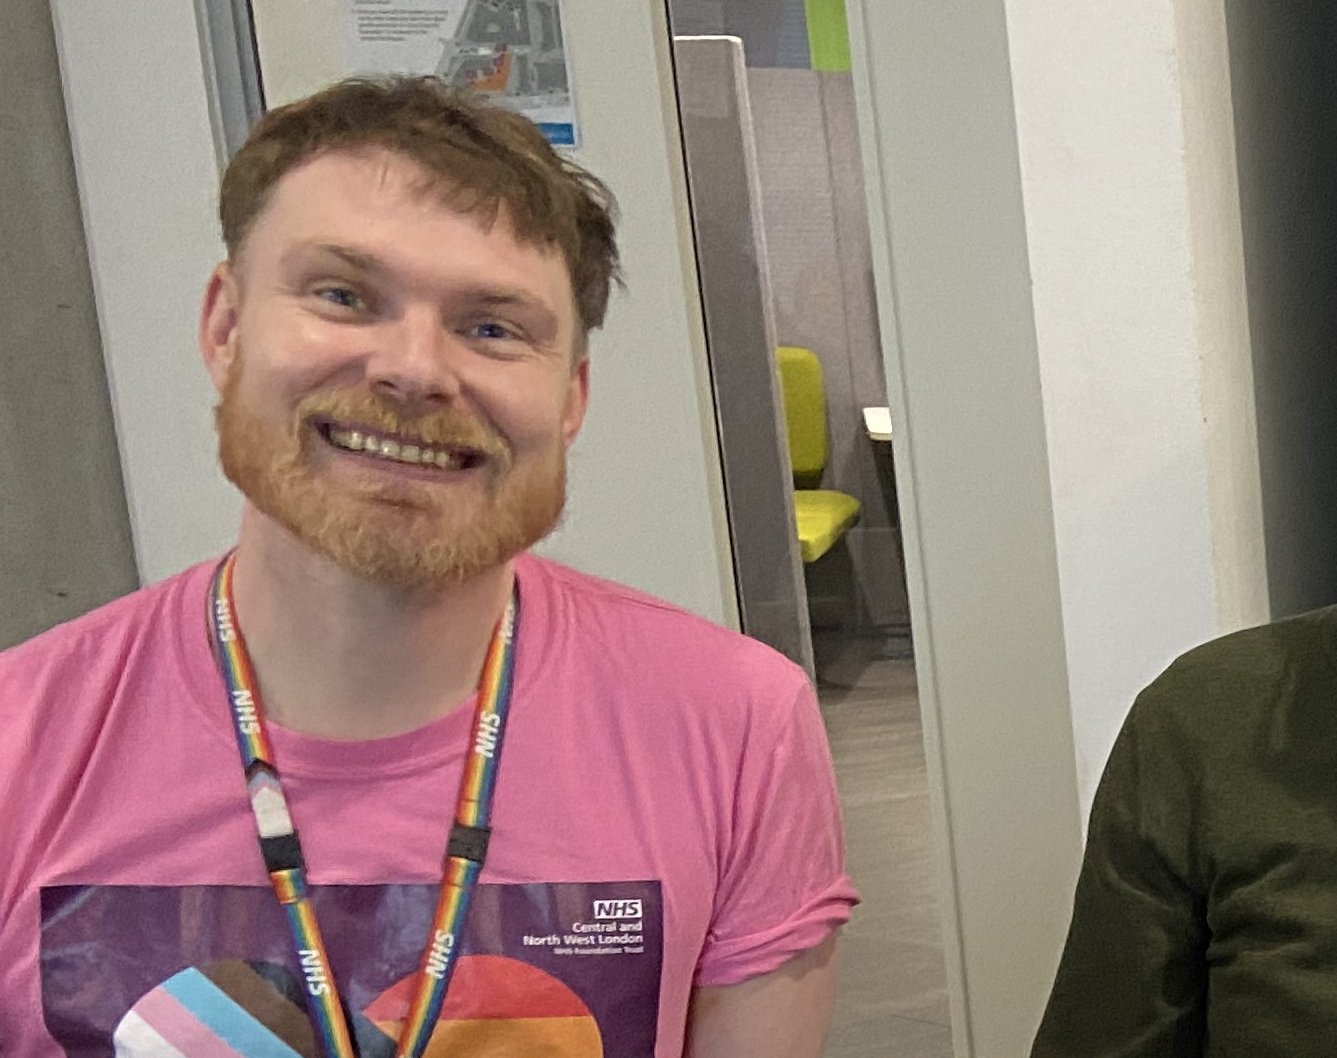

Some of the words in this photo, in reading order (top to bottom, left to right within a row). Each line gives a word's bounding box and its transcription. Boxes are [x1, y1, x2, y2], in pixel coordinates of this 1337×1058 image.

[232, 689, 261, 734] NHS
[475, 711, 500, 758] NHS
[572, 922, 617, 934] Central
[619, 921, 643, 932] and
[597, 902, 640, 917] NHS
[426, 929, 454, 979] NHS
[523, 934, 560, 946] North
[563, 934, 596, 945] West
[598, 933, 643, 944] London
[298, 949, 331, 996] NHS
